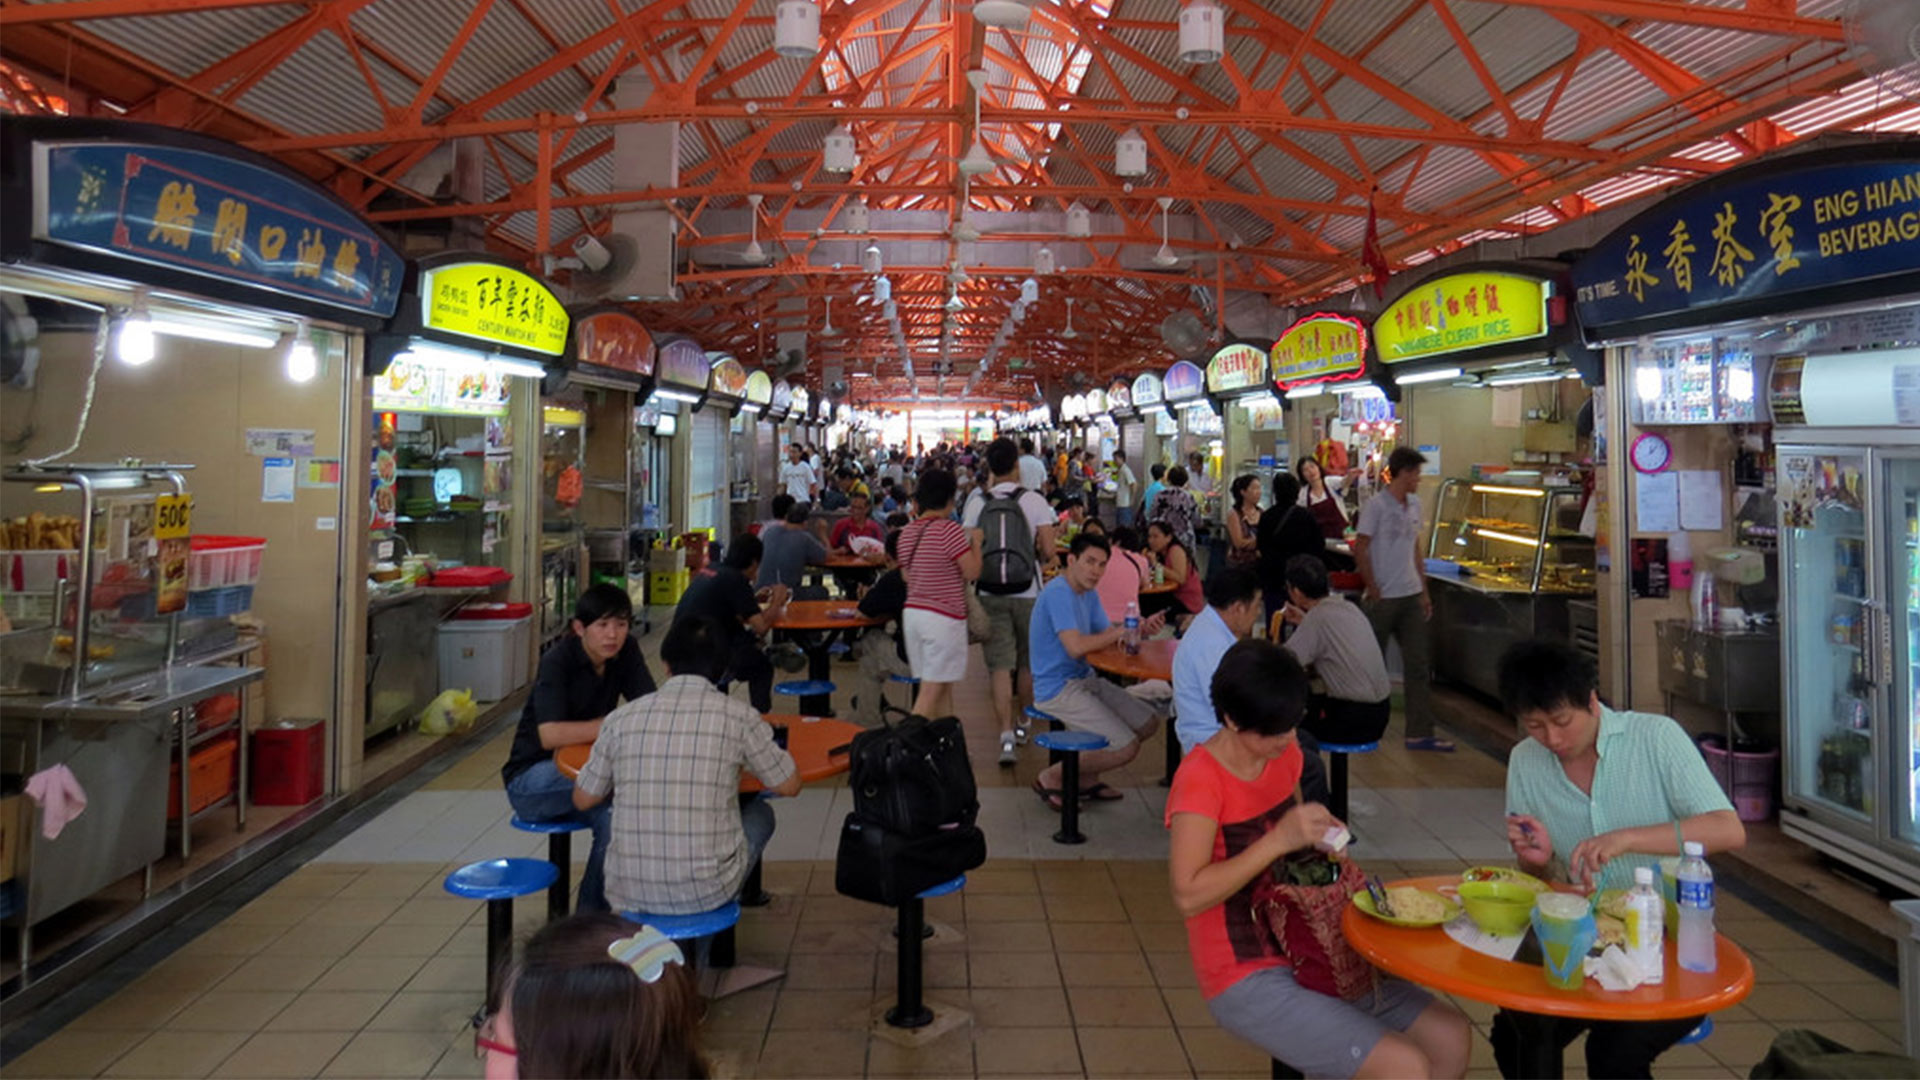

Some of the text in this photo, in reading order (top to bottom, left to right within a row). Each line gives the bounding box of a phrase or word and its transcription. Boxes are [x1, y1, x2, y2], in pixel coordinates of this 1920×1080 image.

[1813, 190, 1860, 224] ENG
[1624, 193, 1802, 303] 永香茶室
[1444, 325, 1479, 345] CURRY
[1483, 318, 1511, 338] RICE
